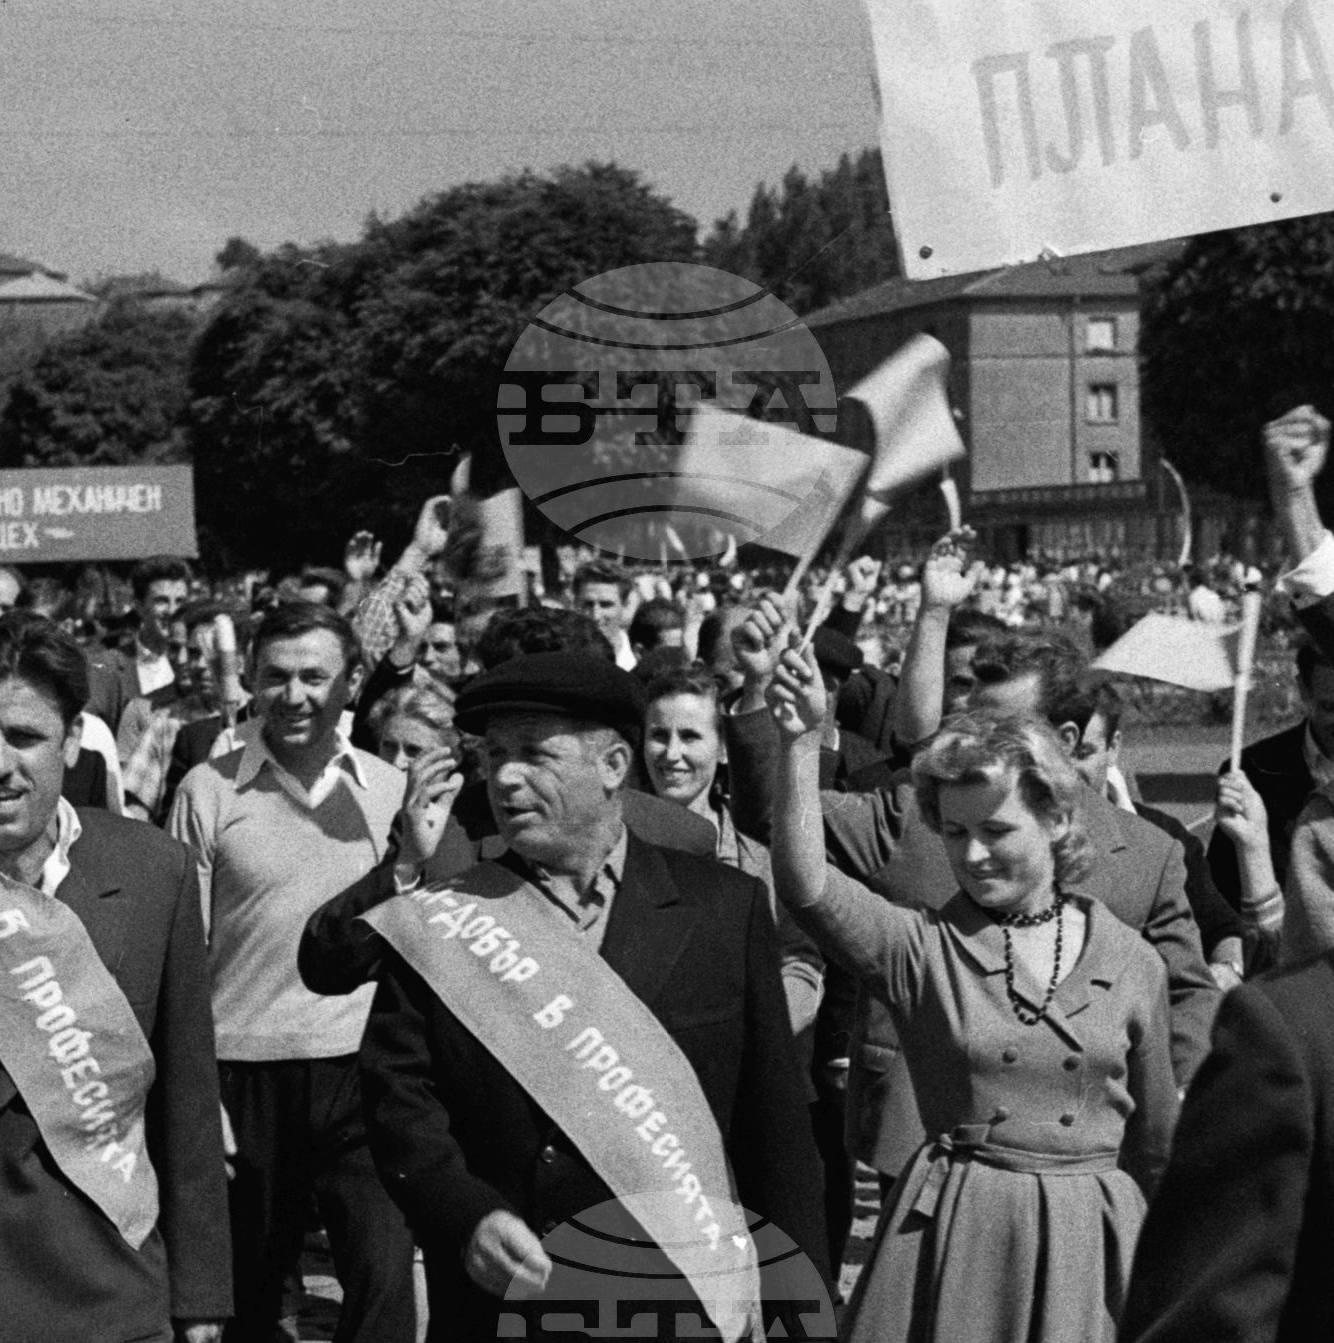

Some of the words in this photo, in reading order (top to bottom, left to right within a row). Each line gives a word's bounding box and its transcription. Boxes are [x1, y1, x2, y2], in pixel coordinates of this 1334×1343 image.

[32, 483, 163, 515] МЕХАНИЧЕН
[532, 994, 574, 1029] В
[568, 1027, 721, 1250] ПРОФЕСИЯТА
